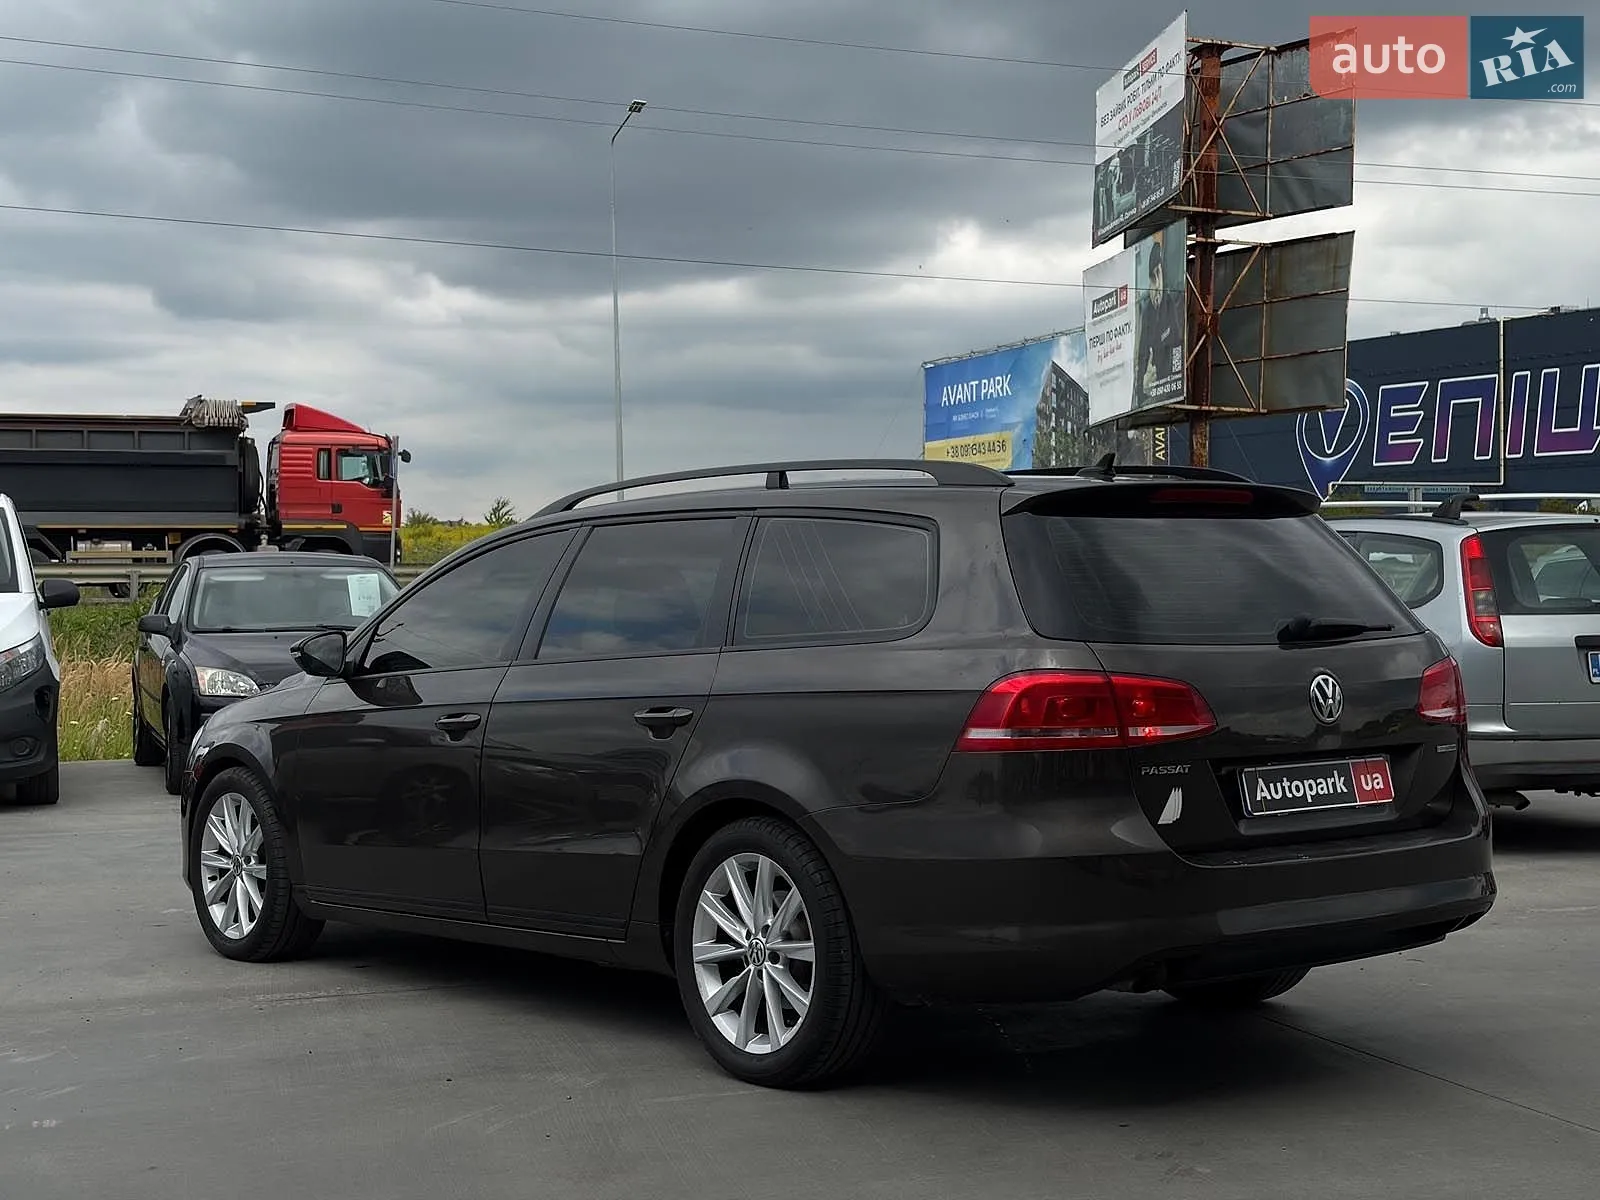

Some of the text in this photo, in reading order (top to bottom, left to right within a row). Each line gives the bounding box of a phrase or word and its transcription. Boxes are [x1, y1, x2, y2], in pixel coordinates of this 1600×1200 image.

[1093, 294, 1118, 315] Autopark
[1106, 328, 1113, 345] ПО
[941, 374, 1012, 407] AVANT PARK
[1141, 764, 1191, 776] PASSAT
[1256, 770, 1385, 803] Autopark ua
